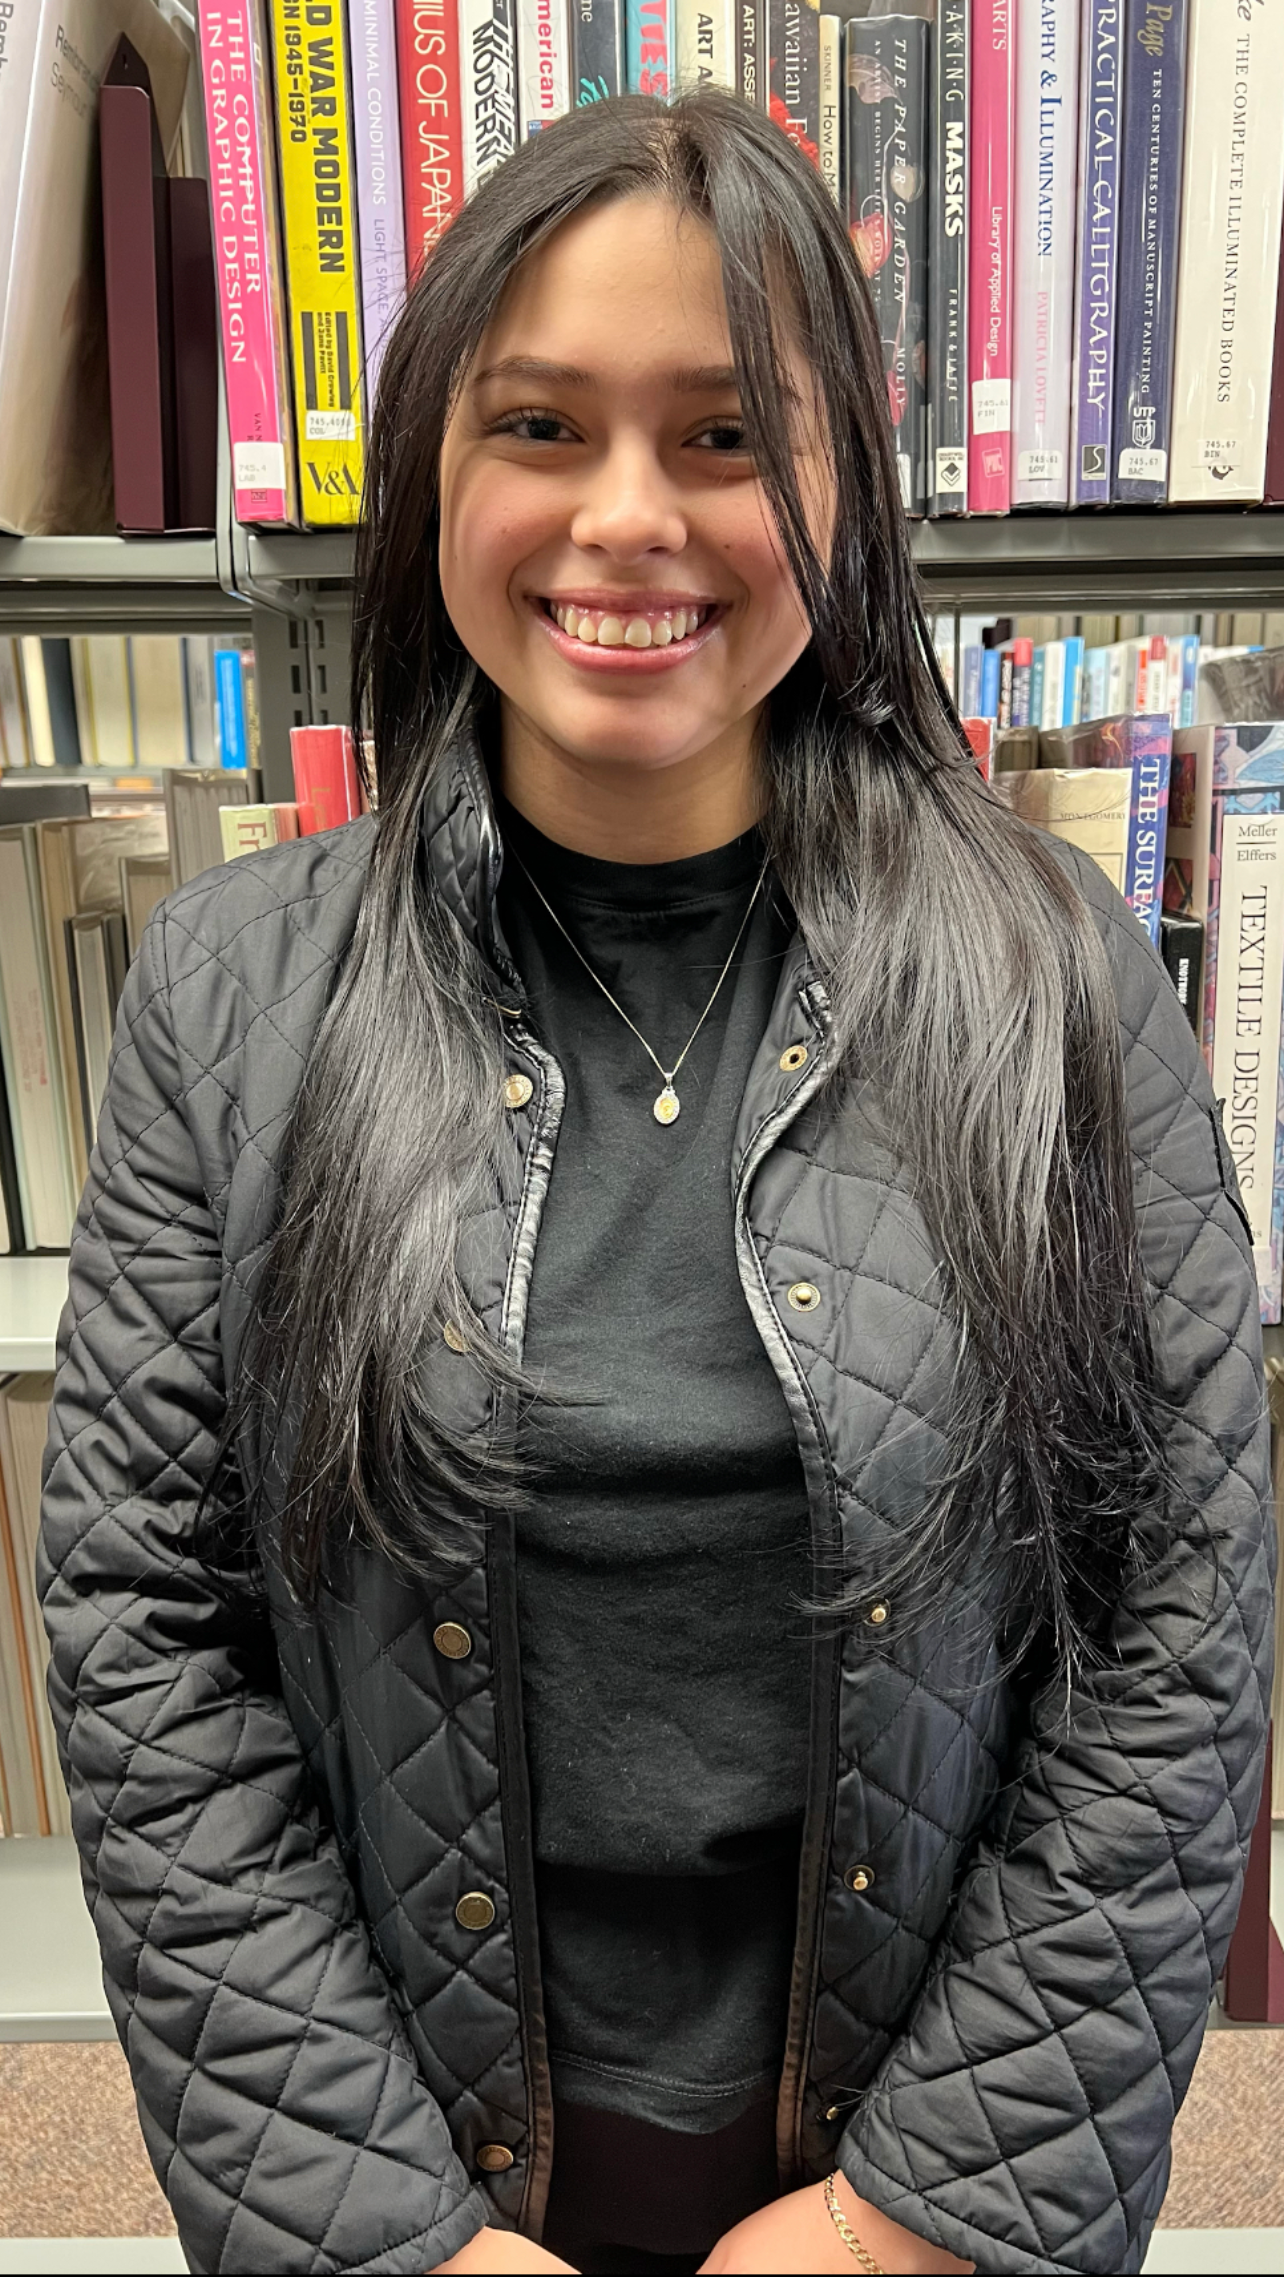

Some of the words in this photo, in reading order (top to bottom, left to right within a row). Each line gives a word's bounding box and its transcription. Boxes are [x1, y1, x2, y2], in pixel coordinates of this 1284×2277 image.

[207, 12, 223, 47] IN
[283, 0, 301, 19] N
[305, 0, 332, 25] D
[413, 0, 446, 55] IUS
[698, 13, 714, 59] ART
[743, 4, 756, 48] ART:
[1041, 0, 1055, 62] APHY
[1137, 2, 1173, 57] Page
[227, 10, 246, 82] THE
[364, 1, 380, 82] MINIMAL
[537, 0, 557, 109] merican
[785, 0, 808, 105] awaiian
[823, 45, 832, 91] SKINNER
[874, 40, 882, 54] AN
[894, 39, 907, 88] THE
[1236, 34, 1250, 76] THE
[284, 26, 307, 143] 1945-1970
[308, 36, 337, 117] WAR
[416, 64, 448, 117] OF
[472, 18, 501, 166] MODERN
[1041, 70, 1058, 89] &
[1094, 0, 1117, 170] RACTICAL
[1153, 69, 1163, 98] TEN
[210, 59, 236, 222] GRAPHIC
[368, 88, 387, 205] CONDITIONS
[823, 105, 836, 145] How
[874, 111, 882, 154] BEGINS
[894, 104, 907, 183] PAPER
[1149, 103, 1161, 191] CENTURIES
[1229, 82, 1248, 190] COMPLETE
[823, 151, 833, 168] to
[874, 160, 882, 182] HER
[945, 122, 964, 238] MASKS
[1038, 95, 1063, 256] ILLUMINATION
[233, 94, 261, 293] COMPUTER
[312, 128, 345, 272] MODERN
[1148, 196, 1157, 214] OF
[894, 202, 906, 303] GARDEN
[988, 206, 1002, 249] Library
[990, 252, 1001, 265] of
[1144, 219, 1157, 316] MANUSCRIPT
[1221, 197, 1242, 332] ILLUMINATED
[222, 235, 246, 362] DESIGN
[949, 289, 958, 337] FRANK
[987, 268, 1001, 313] Applied
[1087, 180, 1112, 411] CALLIGRAPHY
[986, 317, 1002, 357] Design
[1036, 292, 1048, 362] PATRICIA
[896, 347, 906, 404] MOLLY
[1141, 322, 1153, 393] PAINTING
[1217, 339, 1233, 403] BOOKS
[254, 412, 262, 431] VAN
[1133, 406, 1156, 418] UTP
[1138, 758, 1161, 824] THE
[1236, 849, 1277, 862] Elffers
[1238, 825, 1278, 838] Meller
[1236, 885, 1268, 1037] TEXTILE
[1230, 1049, 1260, 1190] DESIGNS
